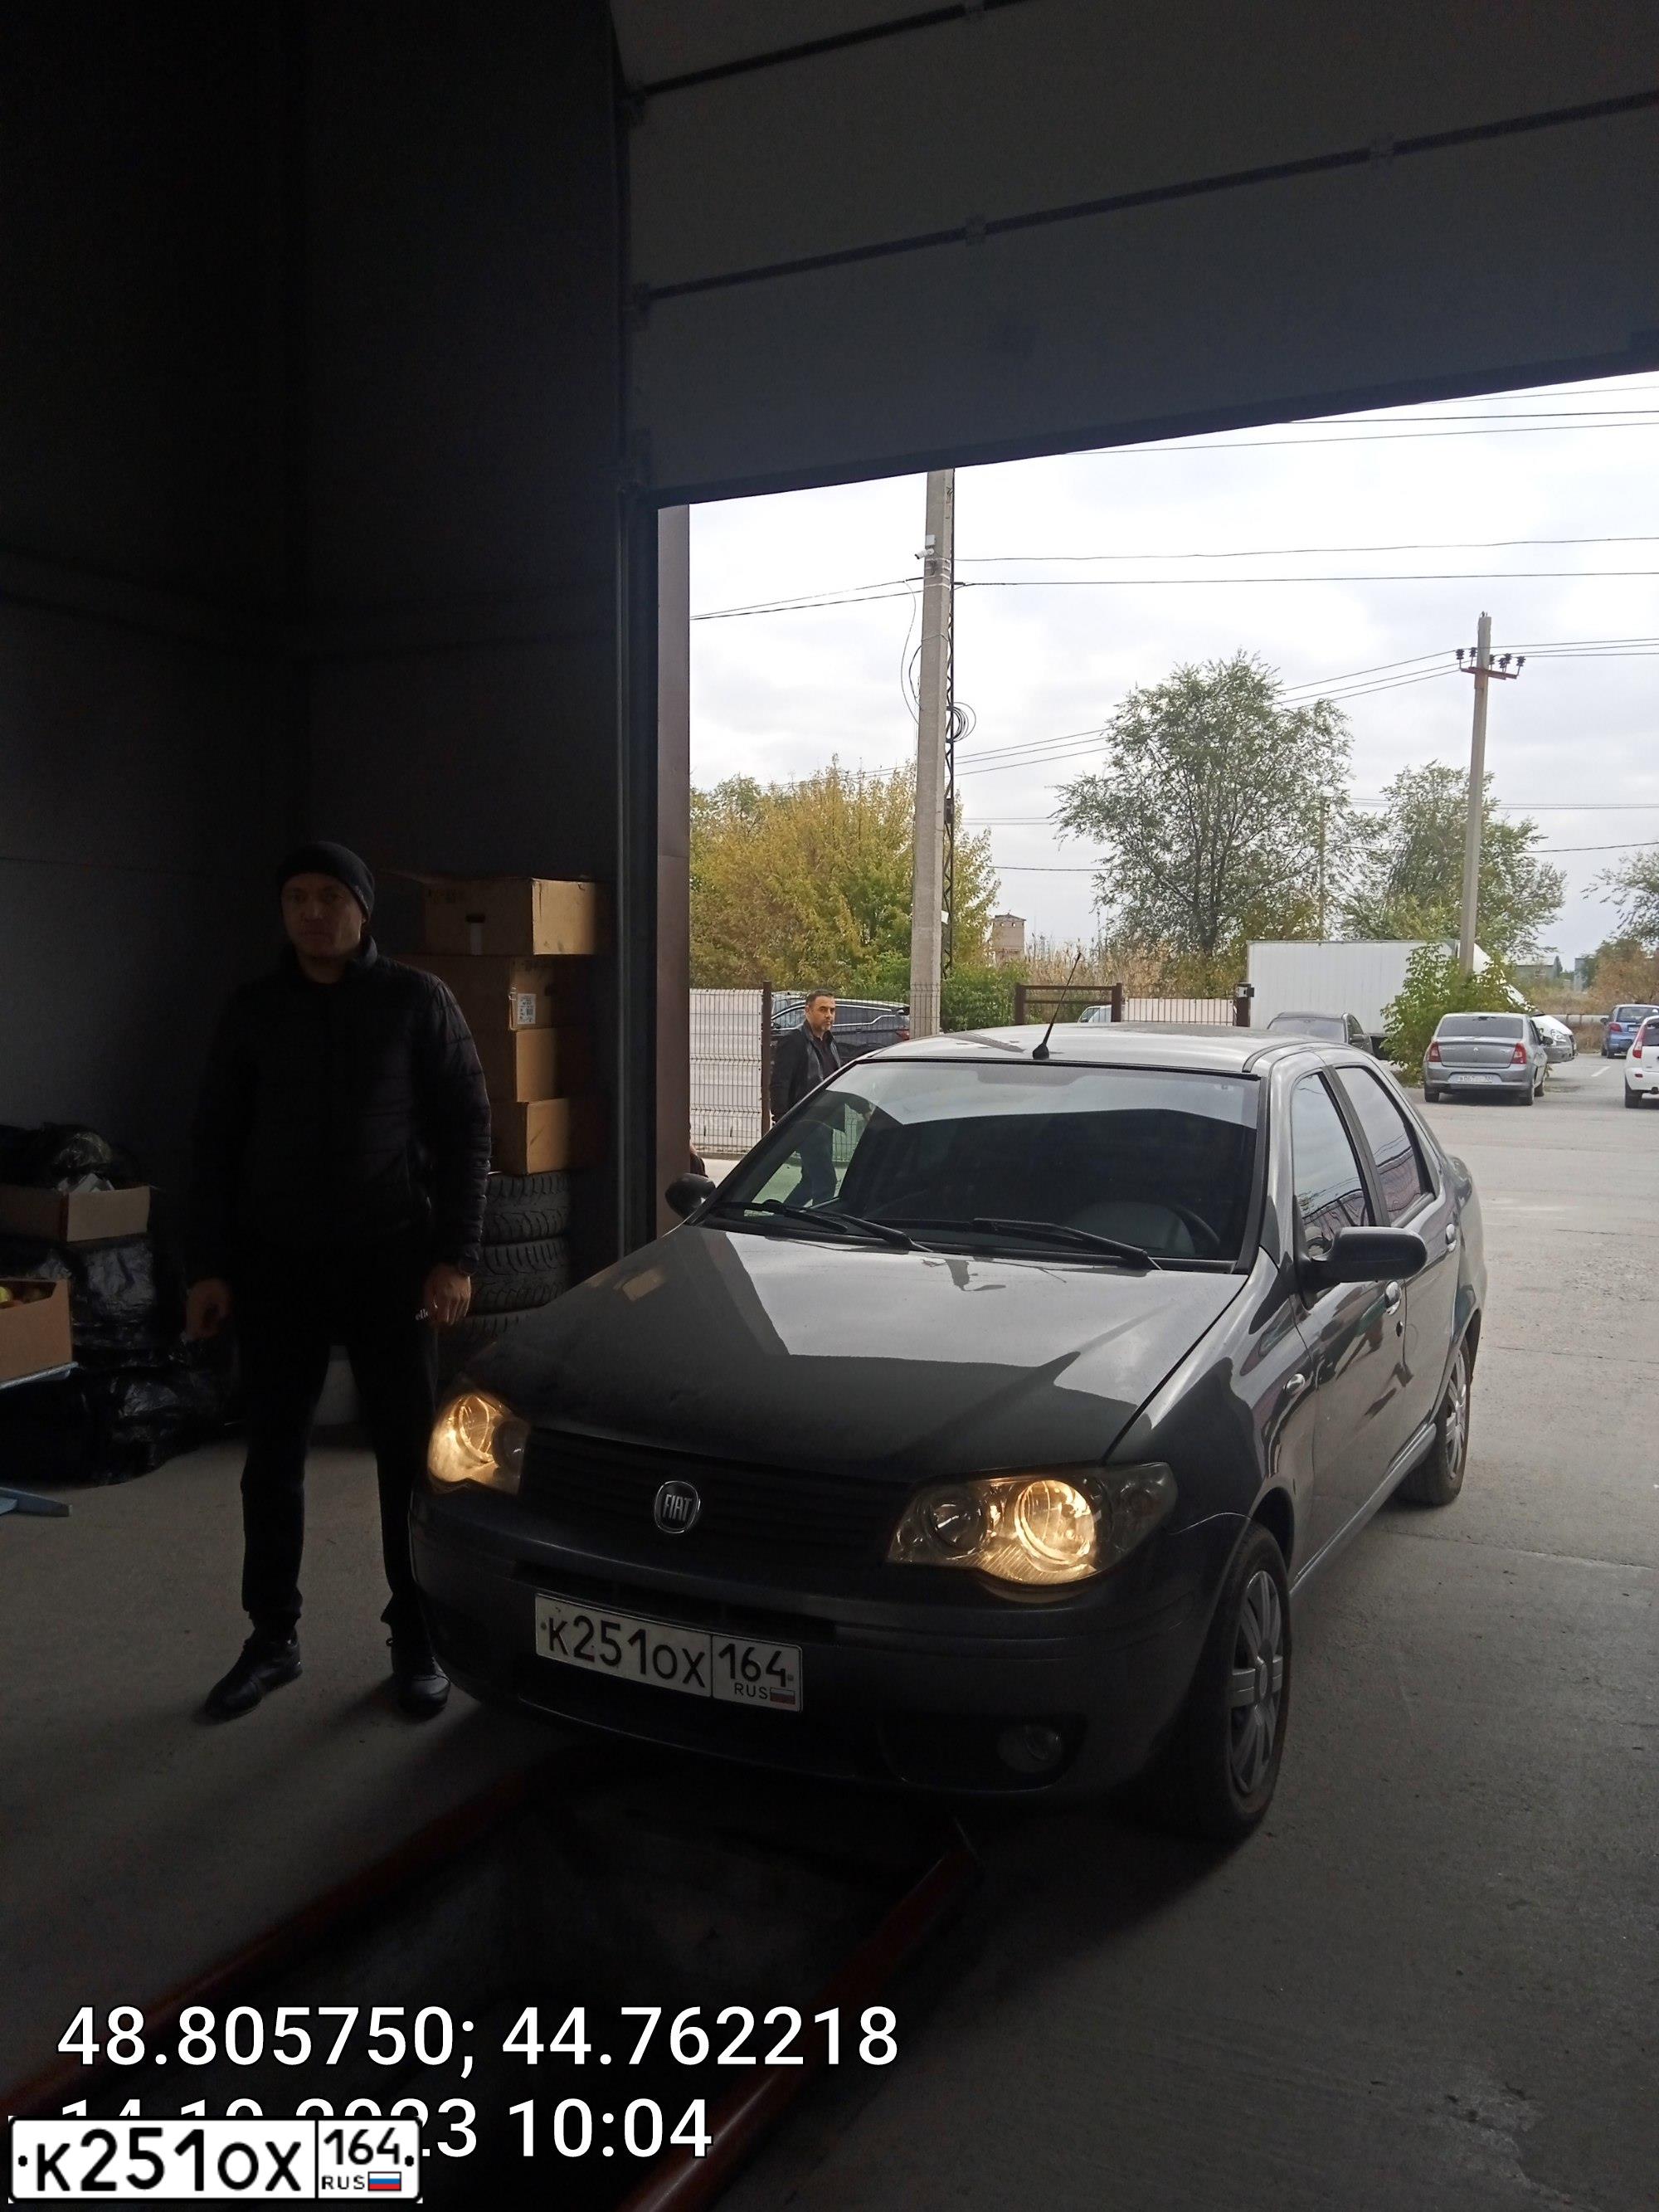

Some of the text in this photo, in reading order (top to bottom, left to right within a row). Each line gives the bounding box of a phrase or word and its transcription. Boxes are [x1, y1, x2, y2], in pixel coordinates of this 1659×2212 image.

[663, 1494, 692, 1521] FIAT
[718, 1643, 786, 1688] 164
[735, 1683, 768, 1700] RUS
